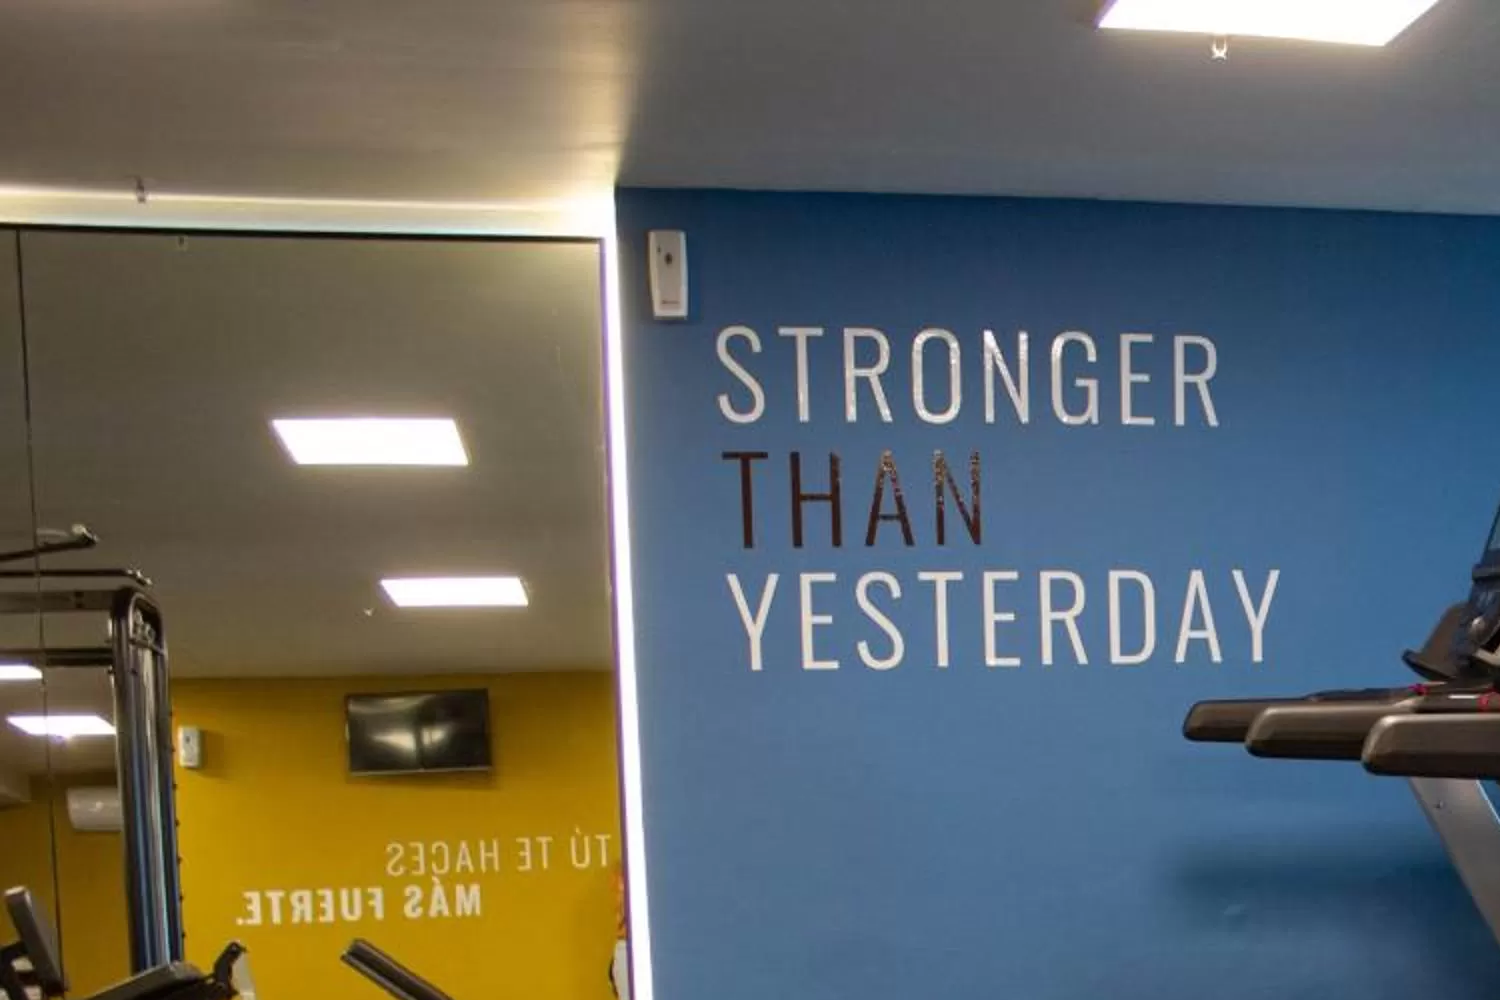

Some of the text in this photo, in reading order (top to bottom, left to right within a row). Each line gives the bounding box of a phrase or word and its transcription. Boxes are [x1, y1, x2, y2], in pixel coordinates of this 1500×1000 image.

[715, 324, 1219, 427] STRONGER
[721, 448, 982, 549] THAN
[726, 568, 1280, 671] YESTERDAY
